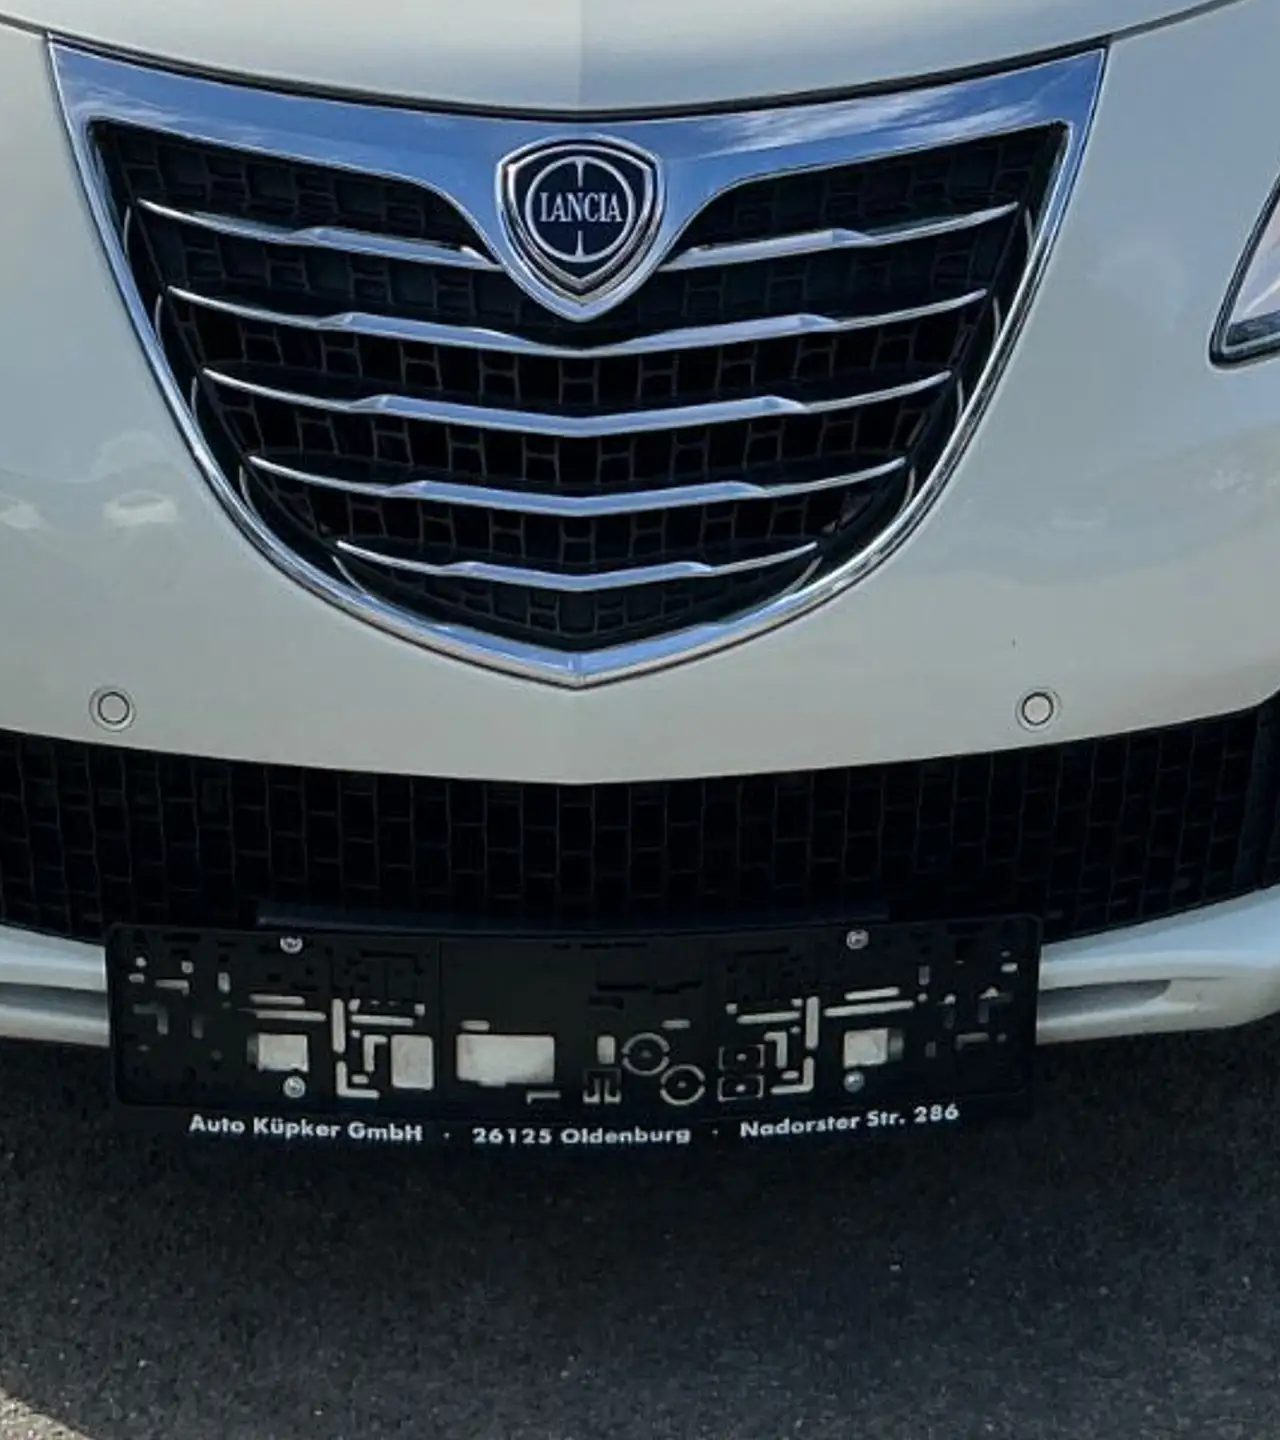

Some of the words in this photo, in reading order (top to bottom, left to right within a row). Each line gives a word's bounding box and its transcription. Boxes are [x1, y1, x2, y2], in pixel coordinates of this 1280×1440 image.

[539, 191, 623, 223] LANCIA
[188, 1114, 246, 1134] Auto
[252, 1116, 341, 1140] Küpker
[347, 1121, 424, 1142] GmbH
[472, 1127, 552, 1145] 26125
[560, 1126, 692, 1145] Oldenburg
[739, 1114, 861, 1139] Nadorster
[866, 1109, 906, 1128] Str.
[913, 1103, 960, 1124] 286
